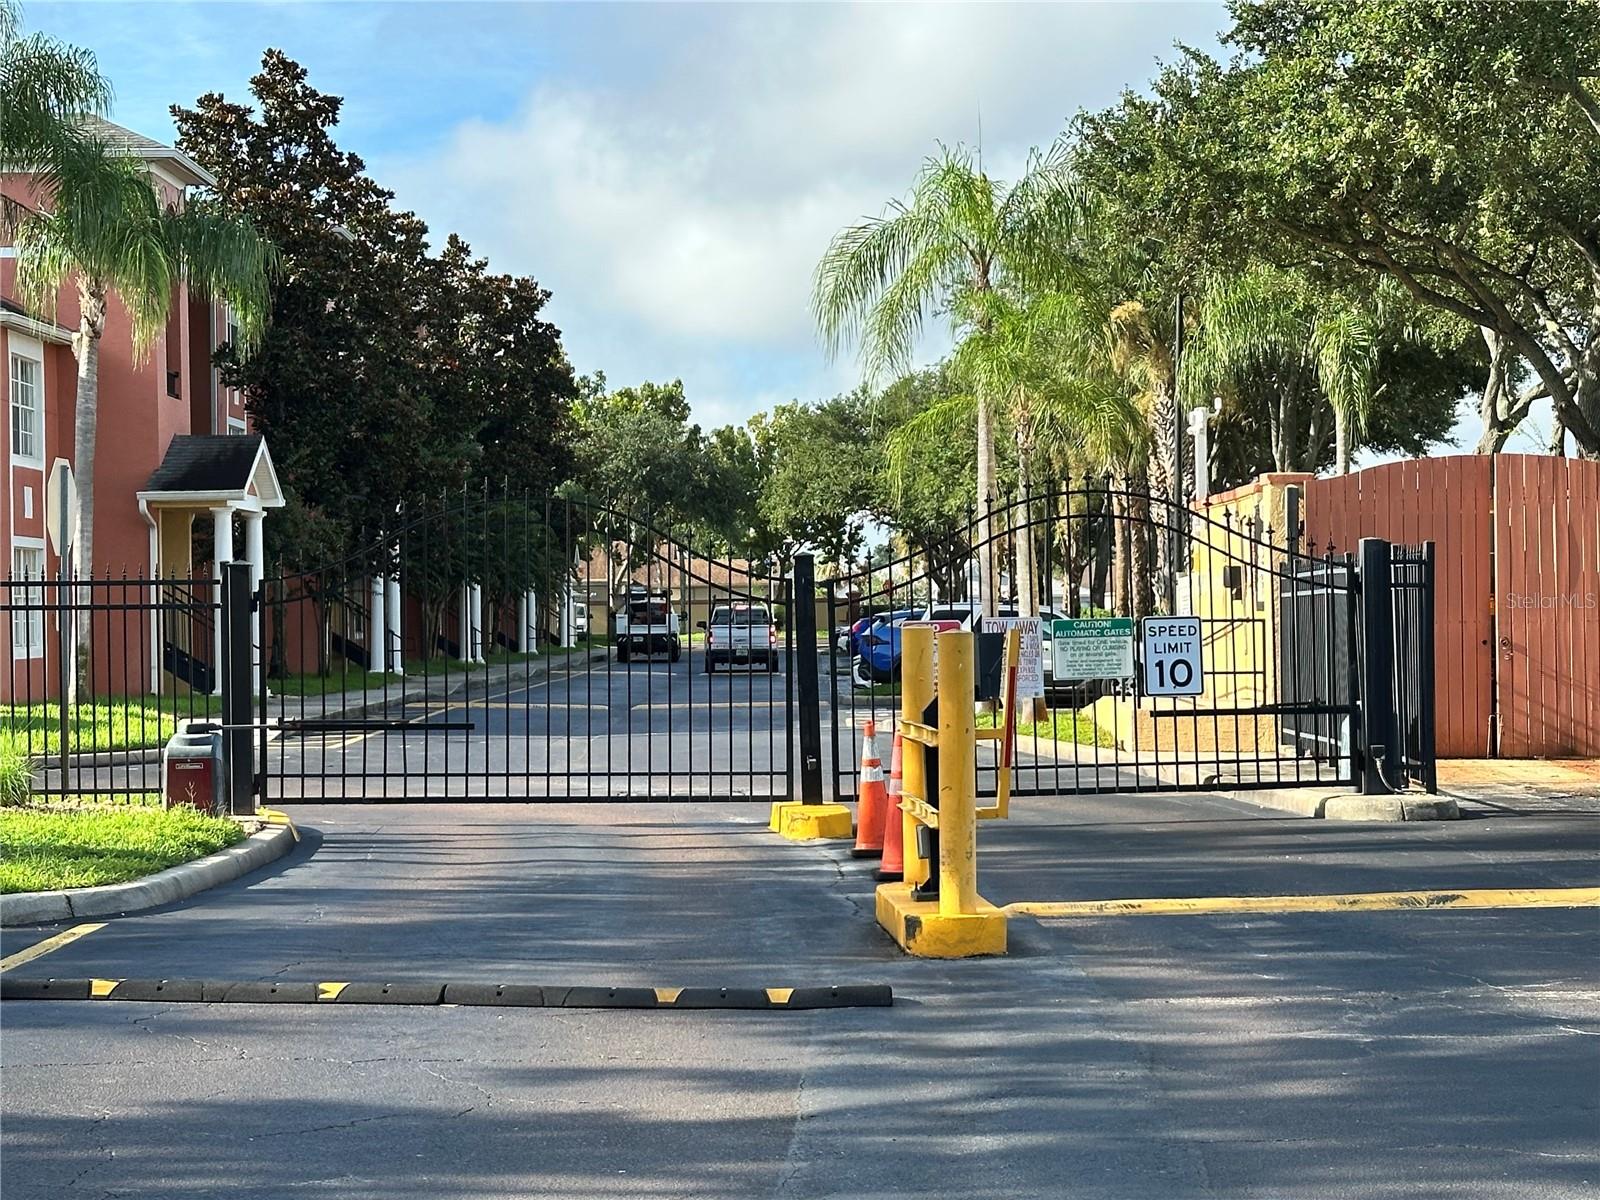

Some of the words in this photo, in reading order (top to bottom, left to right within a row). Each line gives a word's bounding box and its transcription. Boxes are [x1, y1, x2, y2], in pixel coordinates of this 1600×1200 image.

[985, 620, 1008, 633] TOW
[1014, 620, 1039, 634] AWAY
[1055, 629, 1101, 637] AUTOMATIC
[1103, 628, 1131, 636] GATES
[1148, 625, 1197, 637] SPEED
[1154, 642, 1192, 654] LIMIT
[1154, 658, 1193, 688] 10
